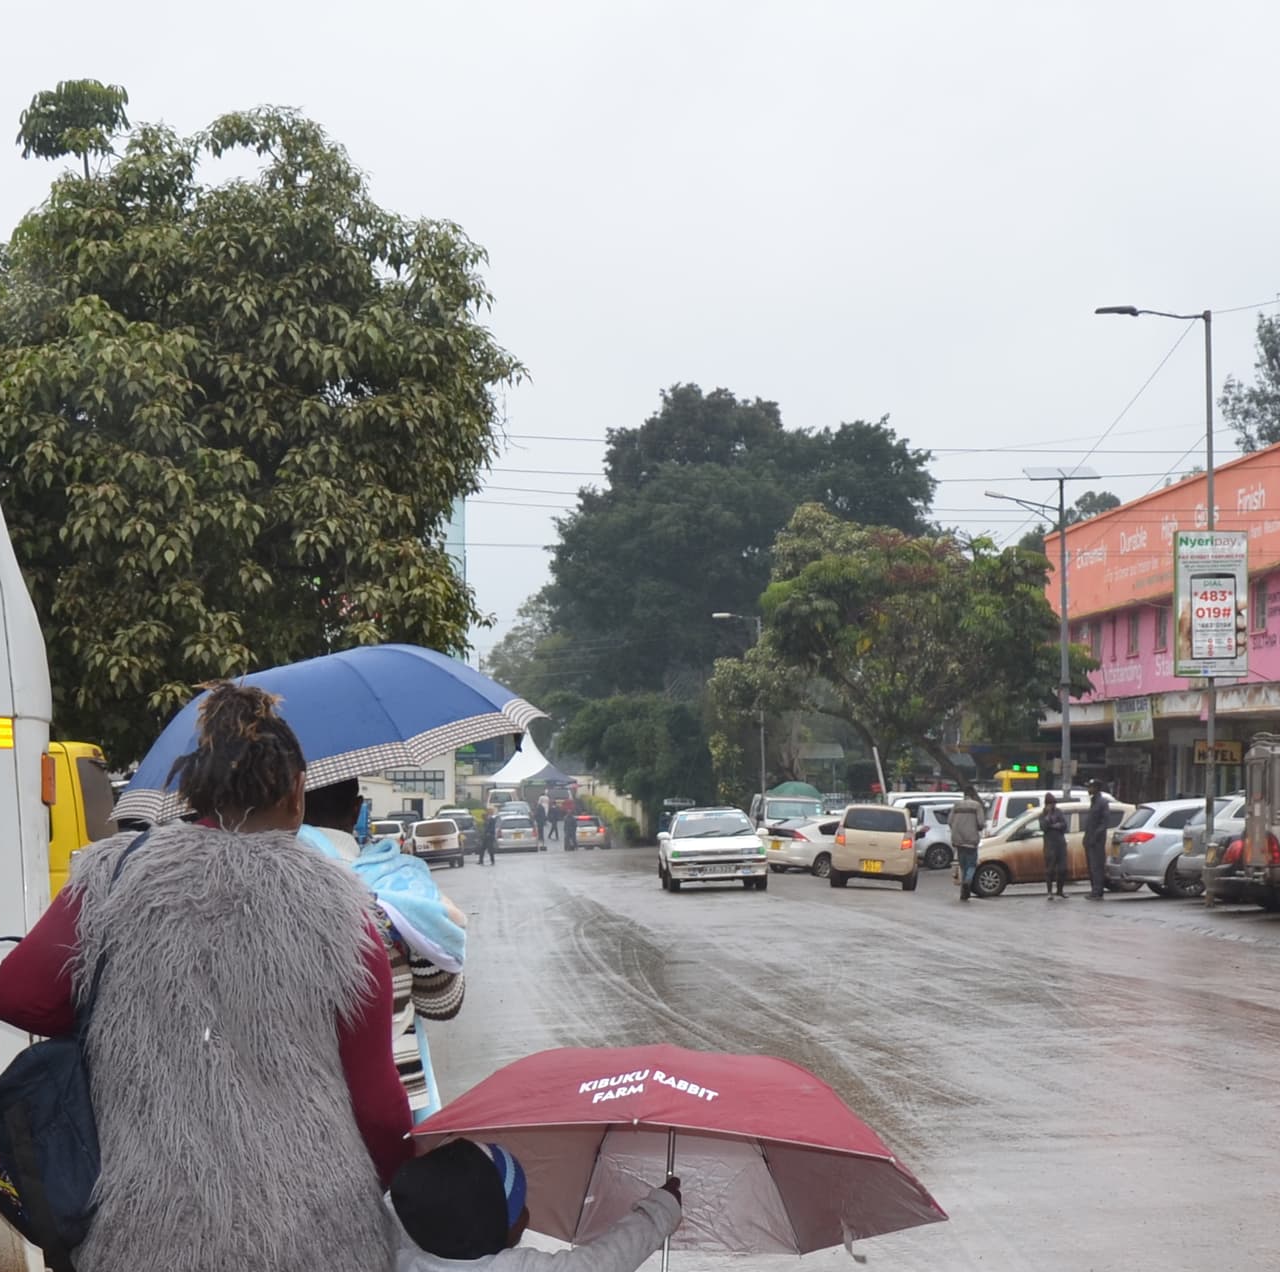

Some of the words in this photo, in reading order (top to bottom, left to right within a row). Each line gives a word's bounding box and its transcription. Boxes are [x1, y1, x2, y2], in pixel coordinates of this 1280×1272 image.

[1120, 525, 1148, 555] Durable
[1237, 482, 1266, 517] Finish
[1196, 607, 1232, 618] 019#
[1198, 750, 1238, 761] HTEL
[579, 1069, 650, 1094] KIBUKU
[652, 1070, 719, 1101] RABBIT
[592, 1083, 644, 1104] FARM
